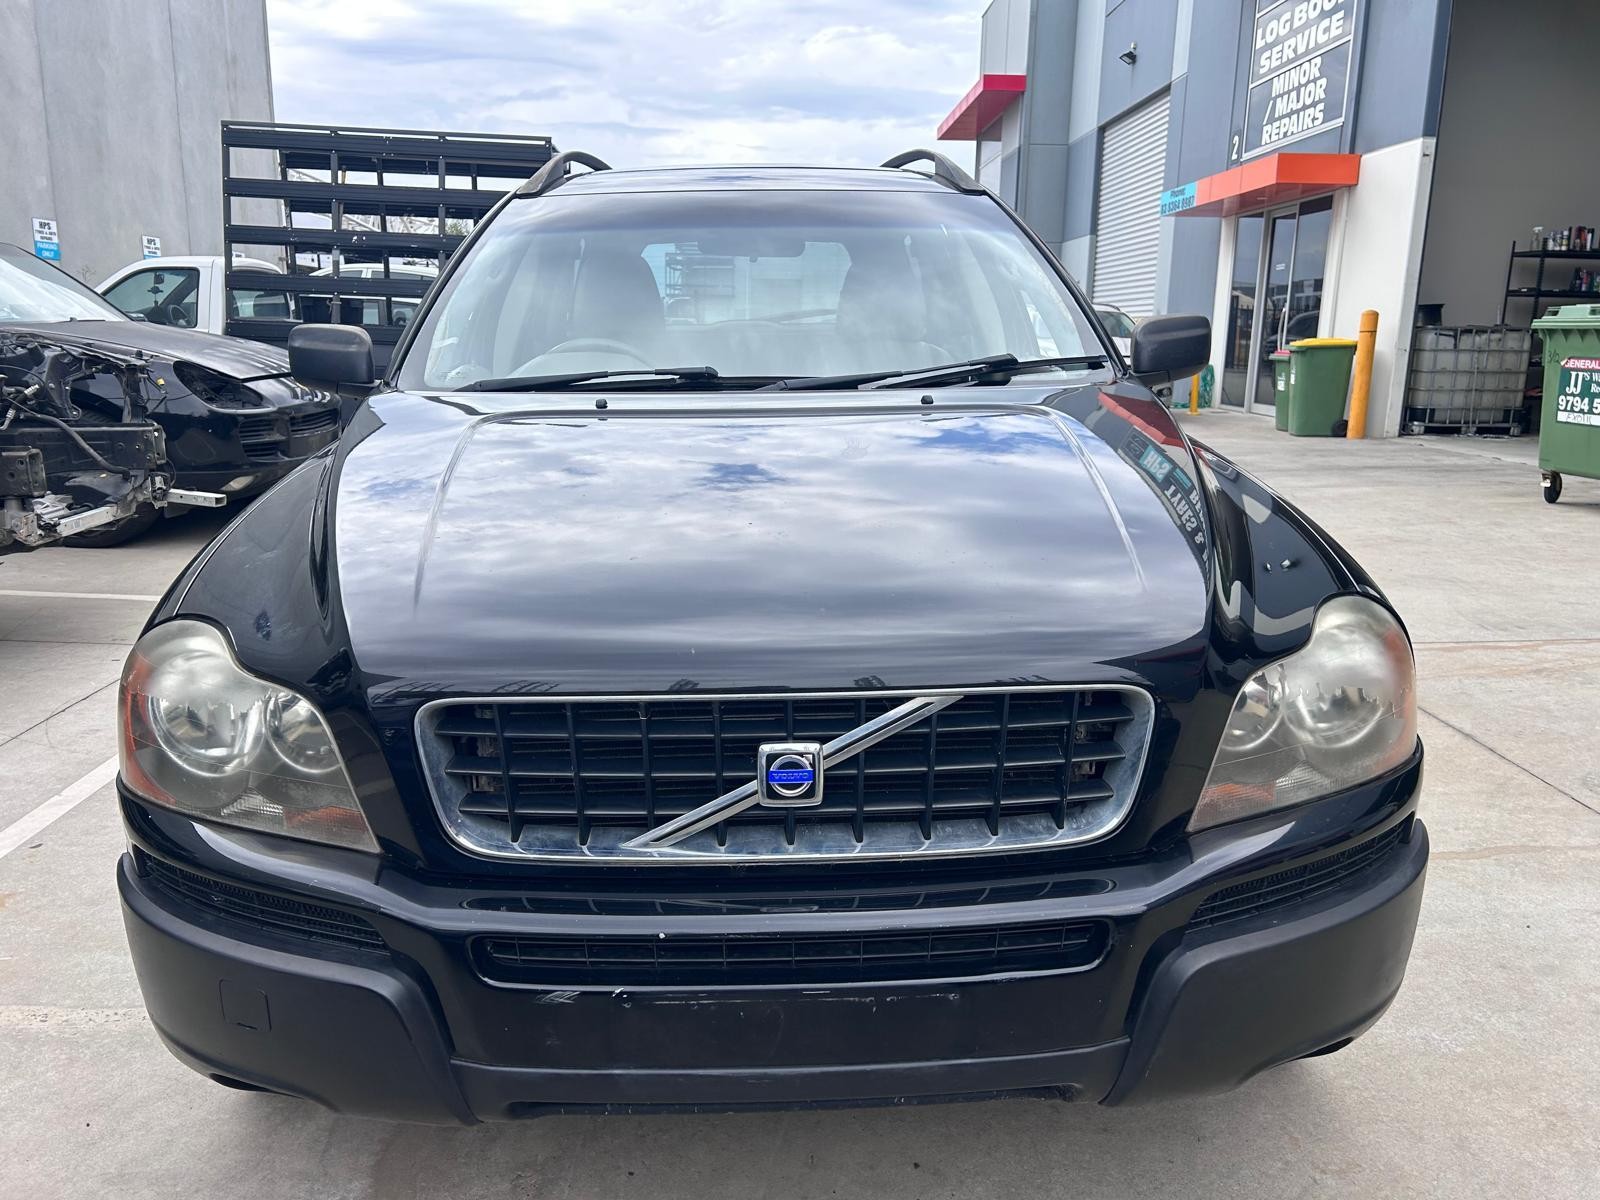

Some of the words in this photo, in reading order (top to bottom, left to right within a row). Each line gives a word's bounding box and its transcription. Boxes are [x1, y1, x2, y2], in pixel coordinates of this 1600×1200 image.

[1256, 12, 1291, 49] LOG
[1293, 0, 1344, 29] BOO
[1259, 10, 1344, 74] SERVICE
[1272, 56, 1321, 97] MINOR
[1262, 103, 1325, 146] REPAIRS
[1231, 135, 1239, 160] 2
[39, 221, 51, 230] HPS
[36, 242, 58, 250] PARKING
[1565, 360, 1600, 369] GENERAL
[1558, 395, 1589, 412] 9794
